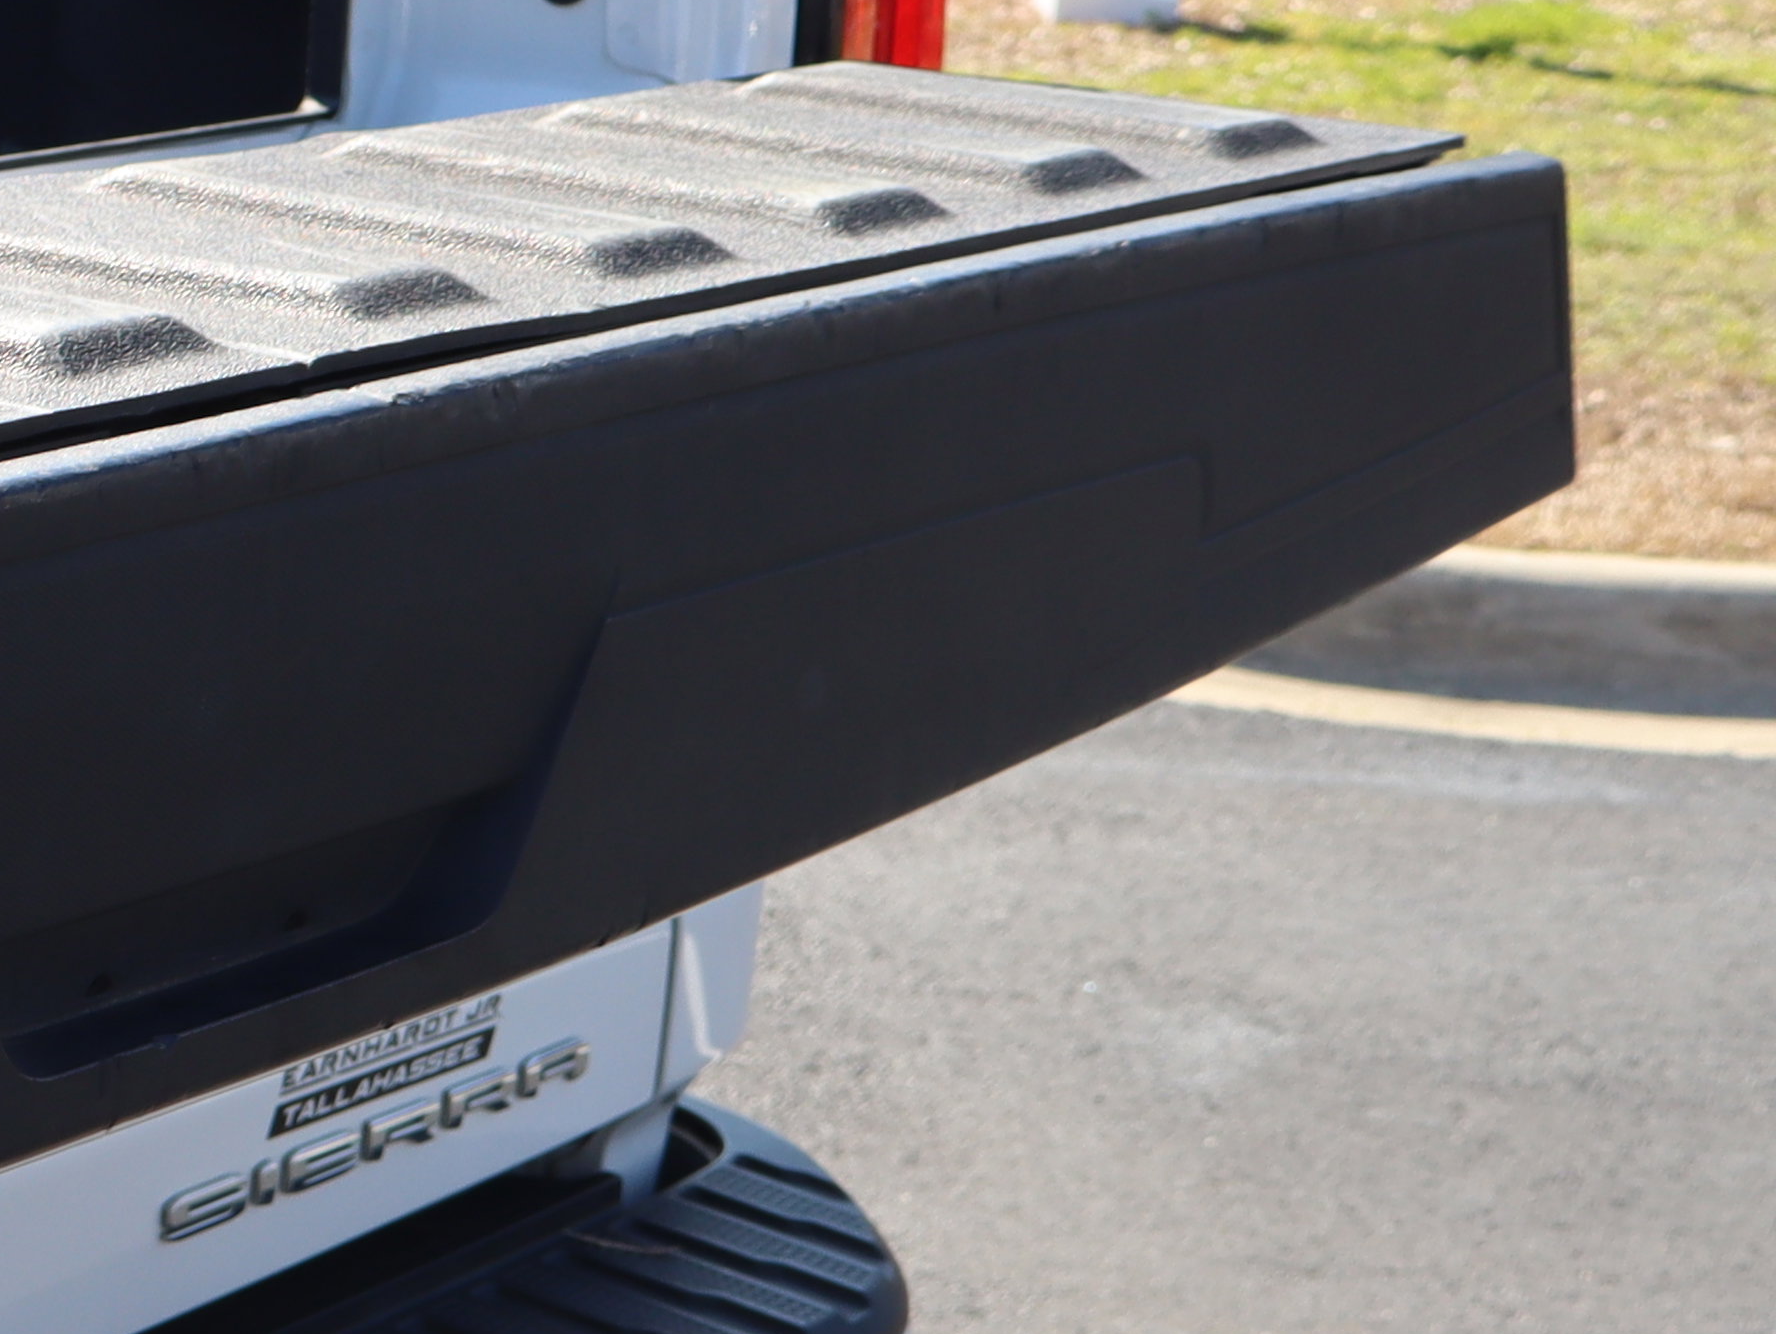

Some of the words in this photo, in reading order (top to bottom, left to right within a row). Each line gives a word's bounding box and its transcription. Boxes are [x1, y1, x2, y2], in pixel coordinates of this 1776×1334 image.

[281, 1008, 458, 1089] EARNHARDT
[281, 1035, 485, 1129] TALLAHASSEE
[159, 1035, 591, 1242] SIERRA
